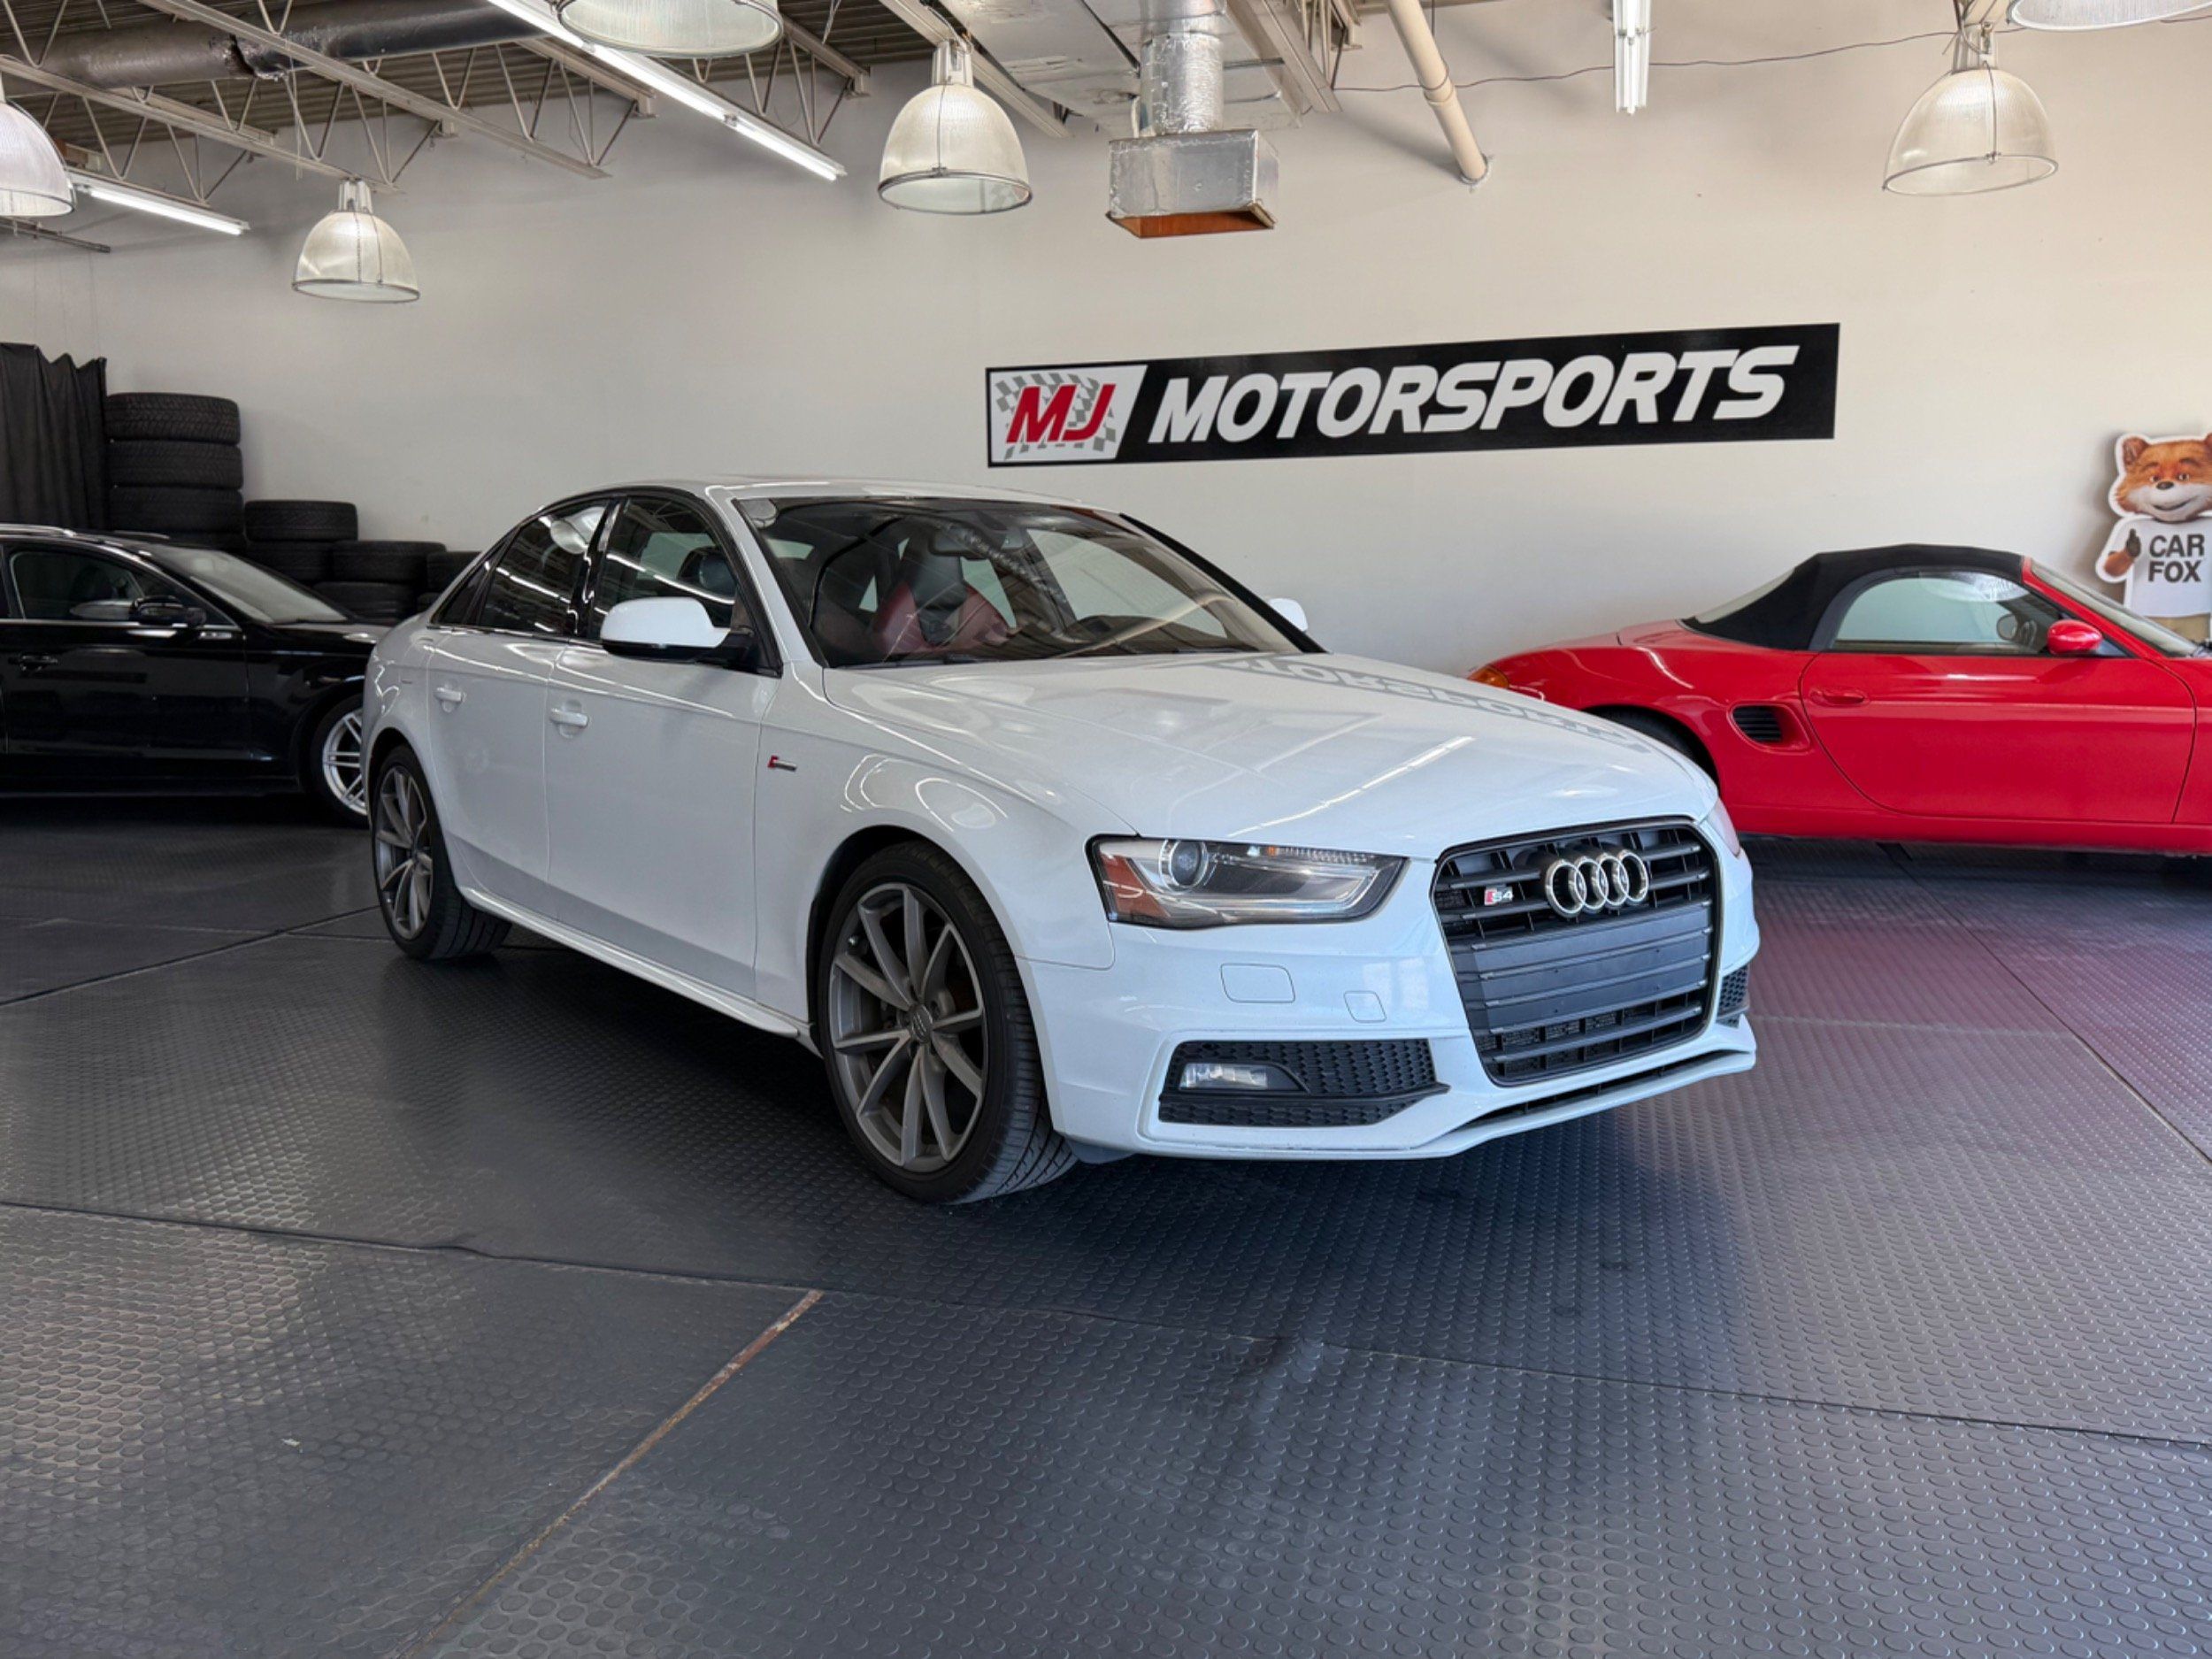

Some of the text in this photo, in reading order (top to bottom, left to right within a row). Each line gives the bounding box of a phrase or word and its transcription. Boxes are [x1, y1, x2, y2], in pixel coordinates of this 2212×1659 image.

[1006, 346, 1800, 443] MJ MOTORSPORTS
[2149, 534, 2205, 557] CAR
[2147, 560, 2201, 582] FOX
[1491, 887, 1514, 903] S4
